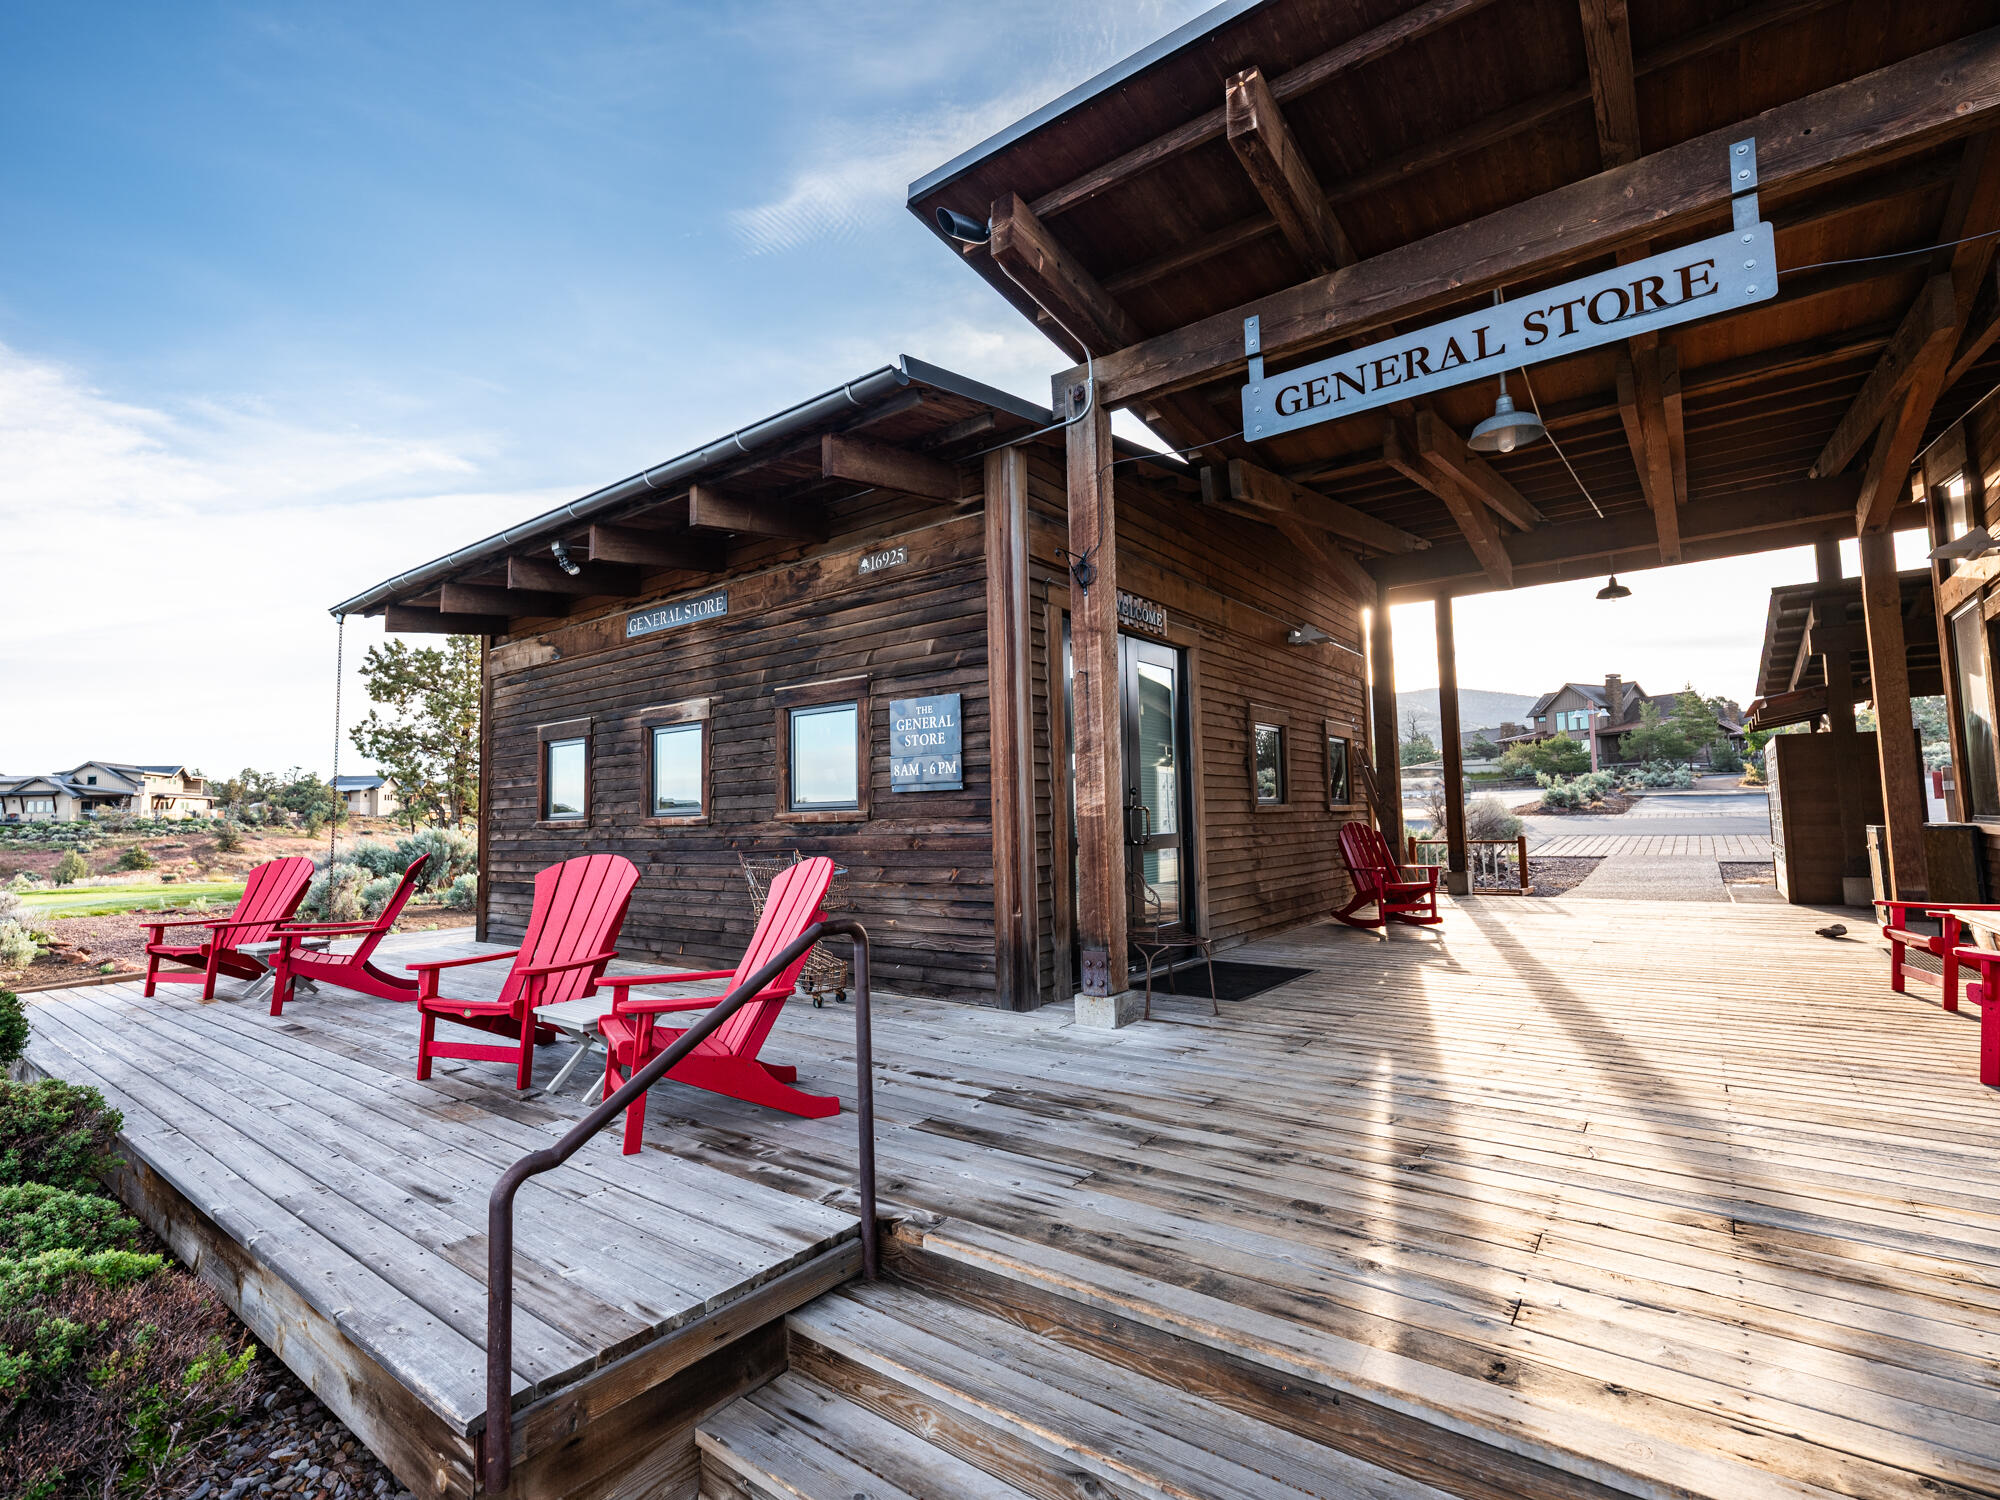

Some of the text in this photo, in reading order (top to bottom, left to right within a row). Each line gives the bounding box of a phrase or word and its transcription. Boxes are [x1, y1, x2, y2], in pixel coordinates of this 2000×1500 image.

[1275, 258, 1719, 418] GENERAL STORE
[871, 547, 904, 570] 16925
[629, 596, 724, 632] GENERAL STORE
[916, 705, 933, 715] THE
[896, 714, 954, 732] GENERAL
[904, 732, 946, 747] STORE
